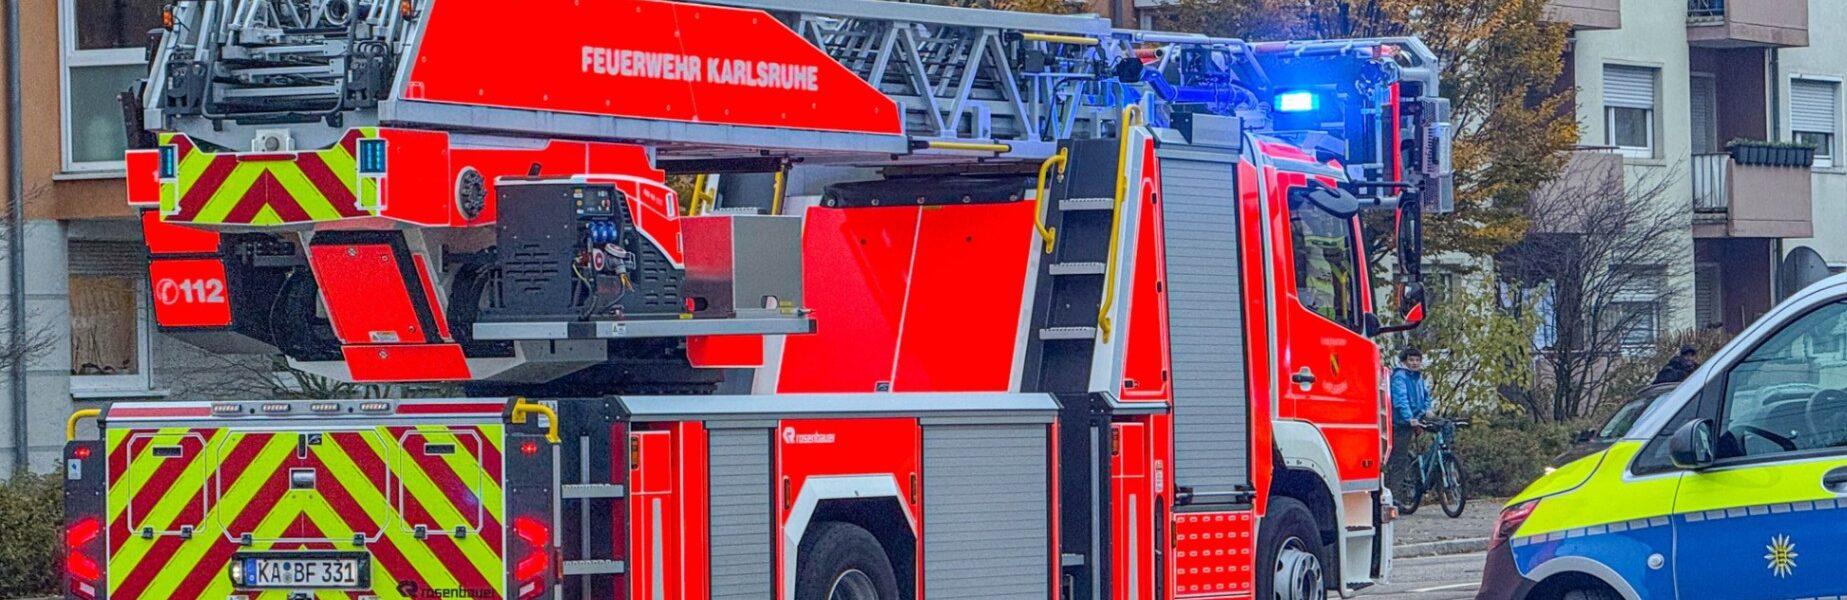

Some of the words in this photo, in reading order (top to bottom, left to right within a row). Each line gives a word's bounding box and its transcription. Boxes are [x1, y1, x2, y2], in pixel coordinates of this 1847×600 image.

[582, 46, 701, 82] FEUERWEHR
[707, 57, 818, 91] KARLSRUHE
[180, 279, 224, 303] 112
[258, 562, 282, 583] KA
[294, 562, 317, 583] BF
[322, 562, 355, 583] 331
